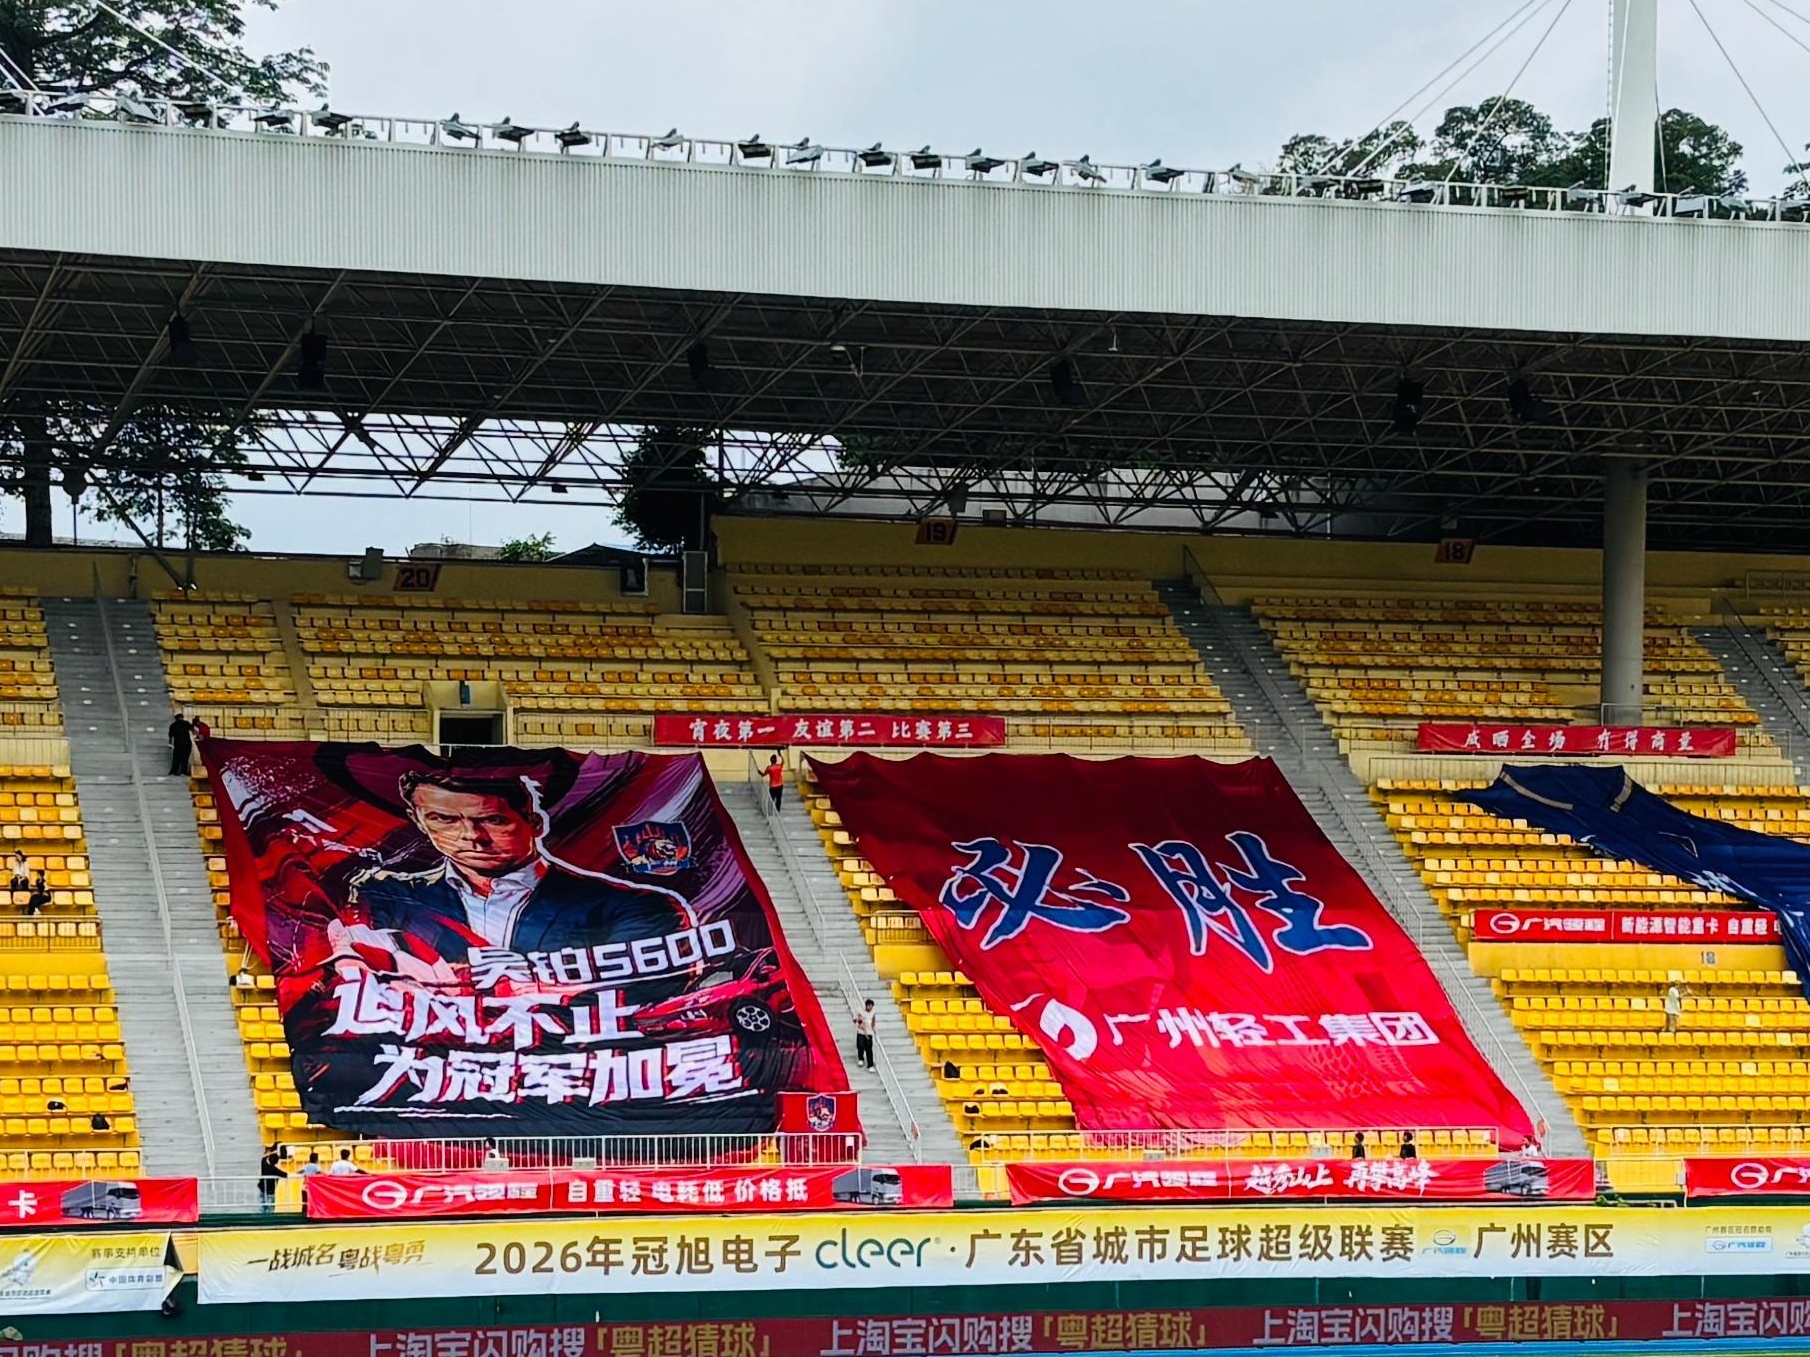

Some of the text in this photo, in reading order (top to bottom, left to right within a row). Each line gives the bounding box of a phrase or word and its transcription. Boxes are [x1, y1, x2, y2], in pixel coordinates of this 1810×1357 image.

[925, 521, 947, 542] 19
[399, 567, 430, 588] 20
[689, 718, 974, 742] 宵夜第一 友谊第二 比赛第三
[321, 966, 647, 1051] 追风不止
[1103, 1007, 1442, 1049] 广州轻工集团
[353, 1035, 745, 1107] 为冠军加冕
[566, 1180, 642, 1203] 自重轻
[474, 1234, 804, 1277] 2026年冠旭电子
[815, 1226, 933, 1270] cleer
[1474, 1223, 1615, 1261] 广州赛区
